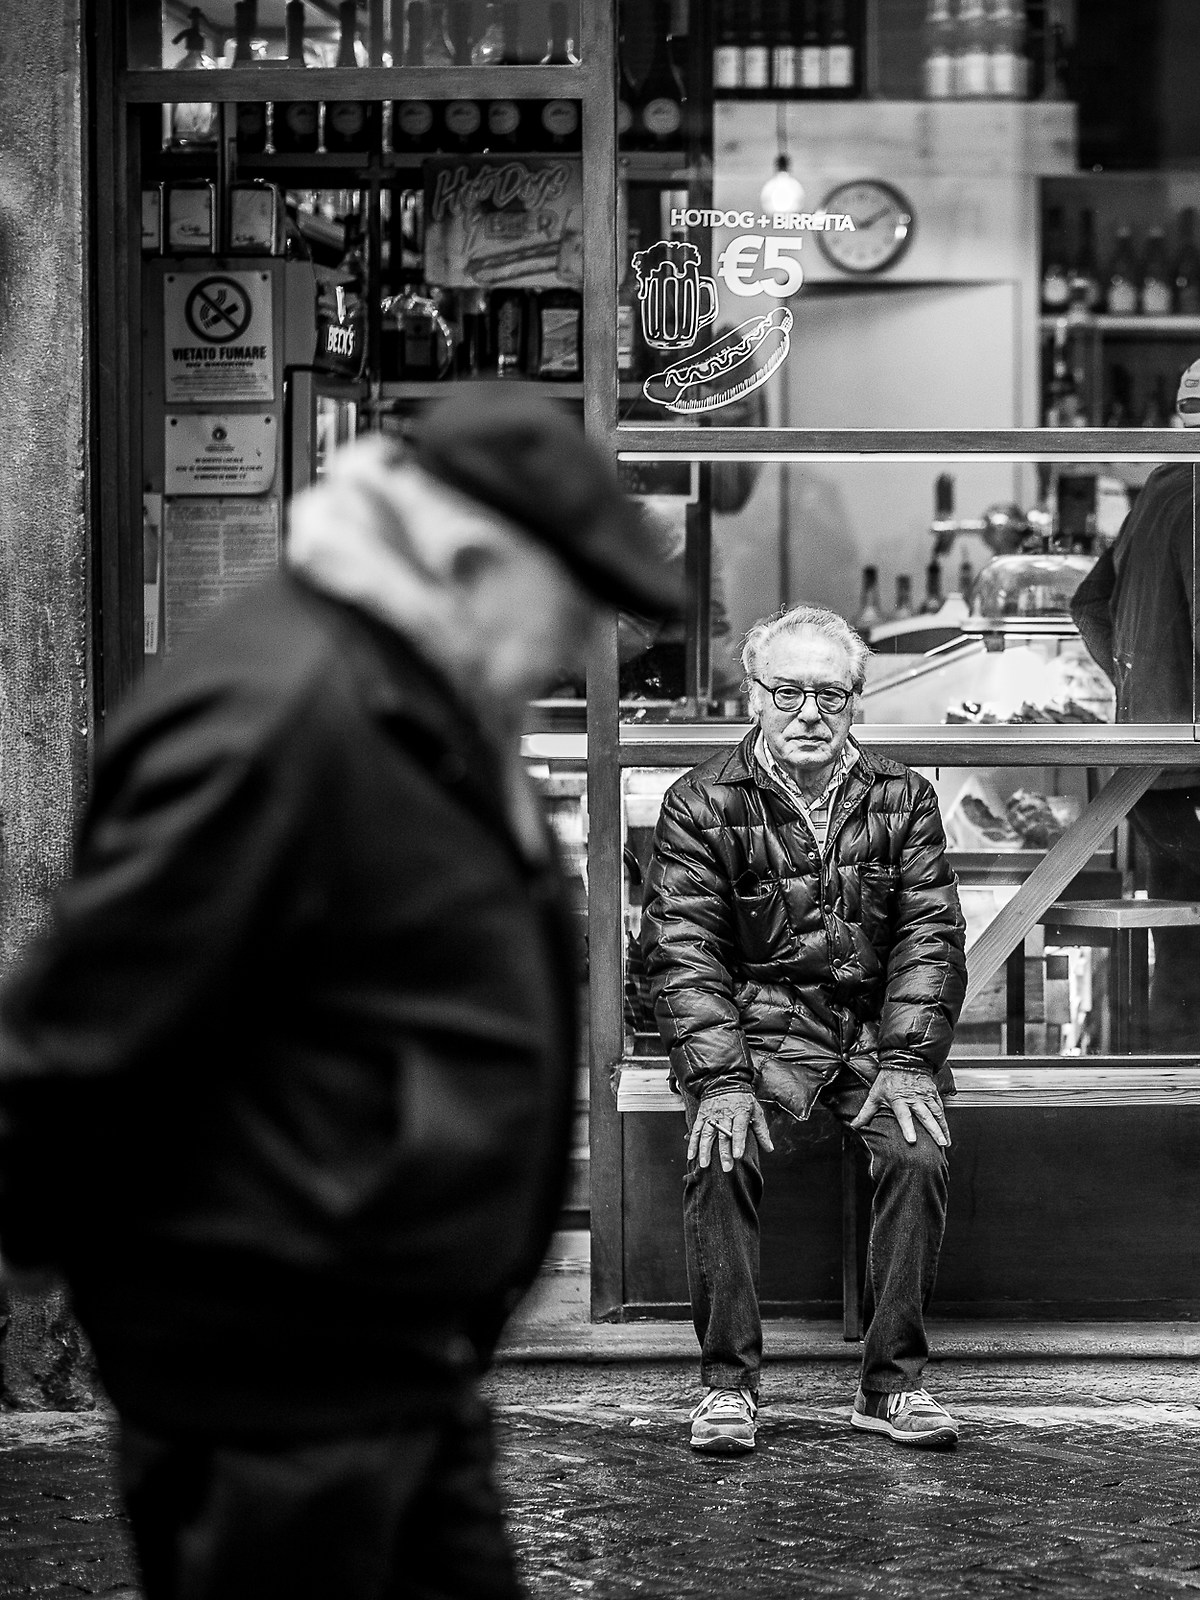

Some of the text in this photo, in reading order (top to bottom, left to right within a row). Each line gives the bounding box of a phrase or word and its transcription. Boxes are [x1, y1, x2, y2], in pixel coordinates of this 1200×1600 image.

[670, 208, 856, 232] HOTDOG + BIRRETTA
[717, 234, 804, 298] €5
[172, 345, 267, 361] VIETATO FUMARE
[327, 324, 354, 357] BECK'S
